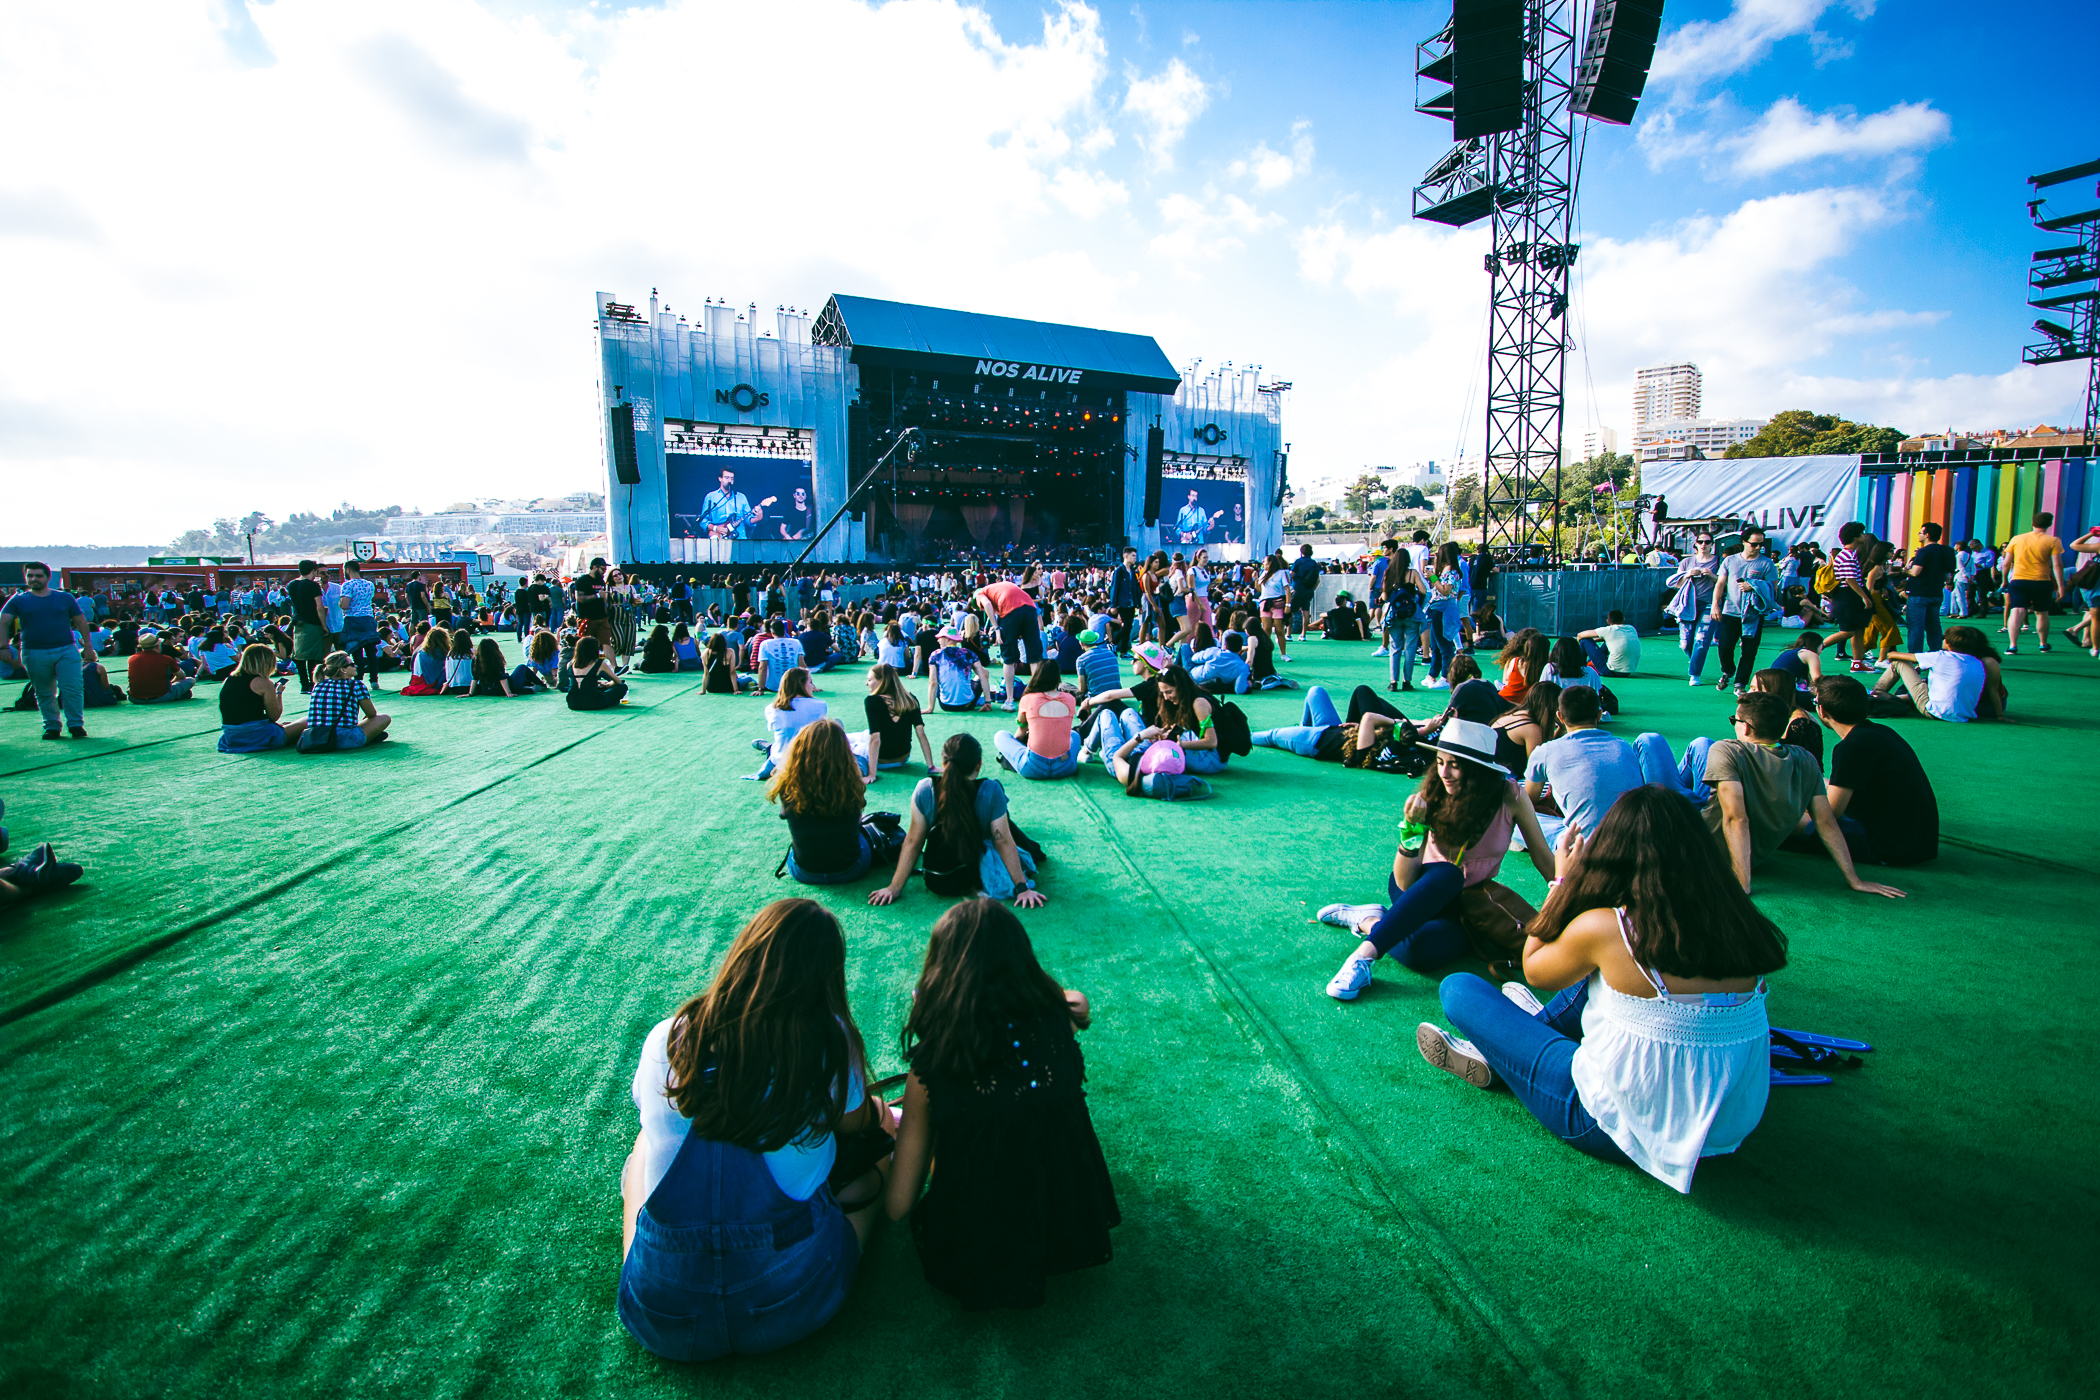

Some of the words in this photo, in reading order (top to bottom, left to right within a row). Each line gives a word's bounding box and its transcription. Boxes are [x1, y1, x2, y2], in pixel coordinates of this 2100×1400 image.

[975, 360, 1020, 378] NOS
[1022, 365, 1083, 384] ALIVE
[715, 383, 770, 412] NOS
[1193, 423, 1228, 445] NOS
[1740, 504, 1826, 532] ALIVE
[380, 540, 456, 562] SAGRES
